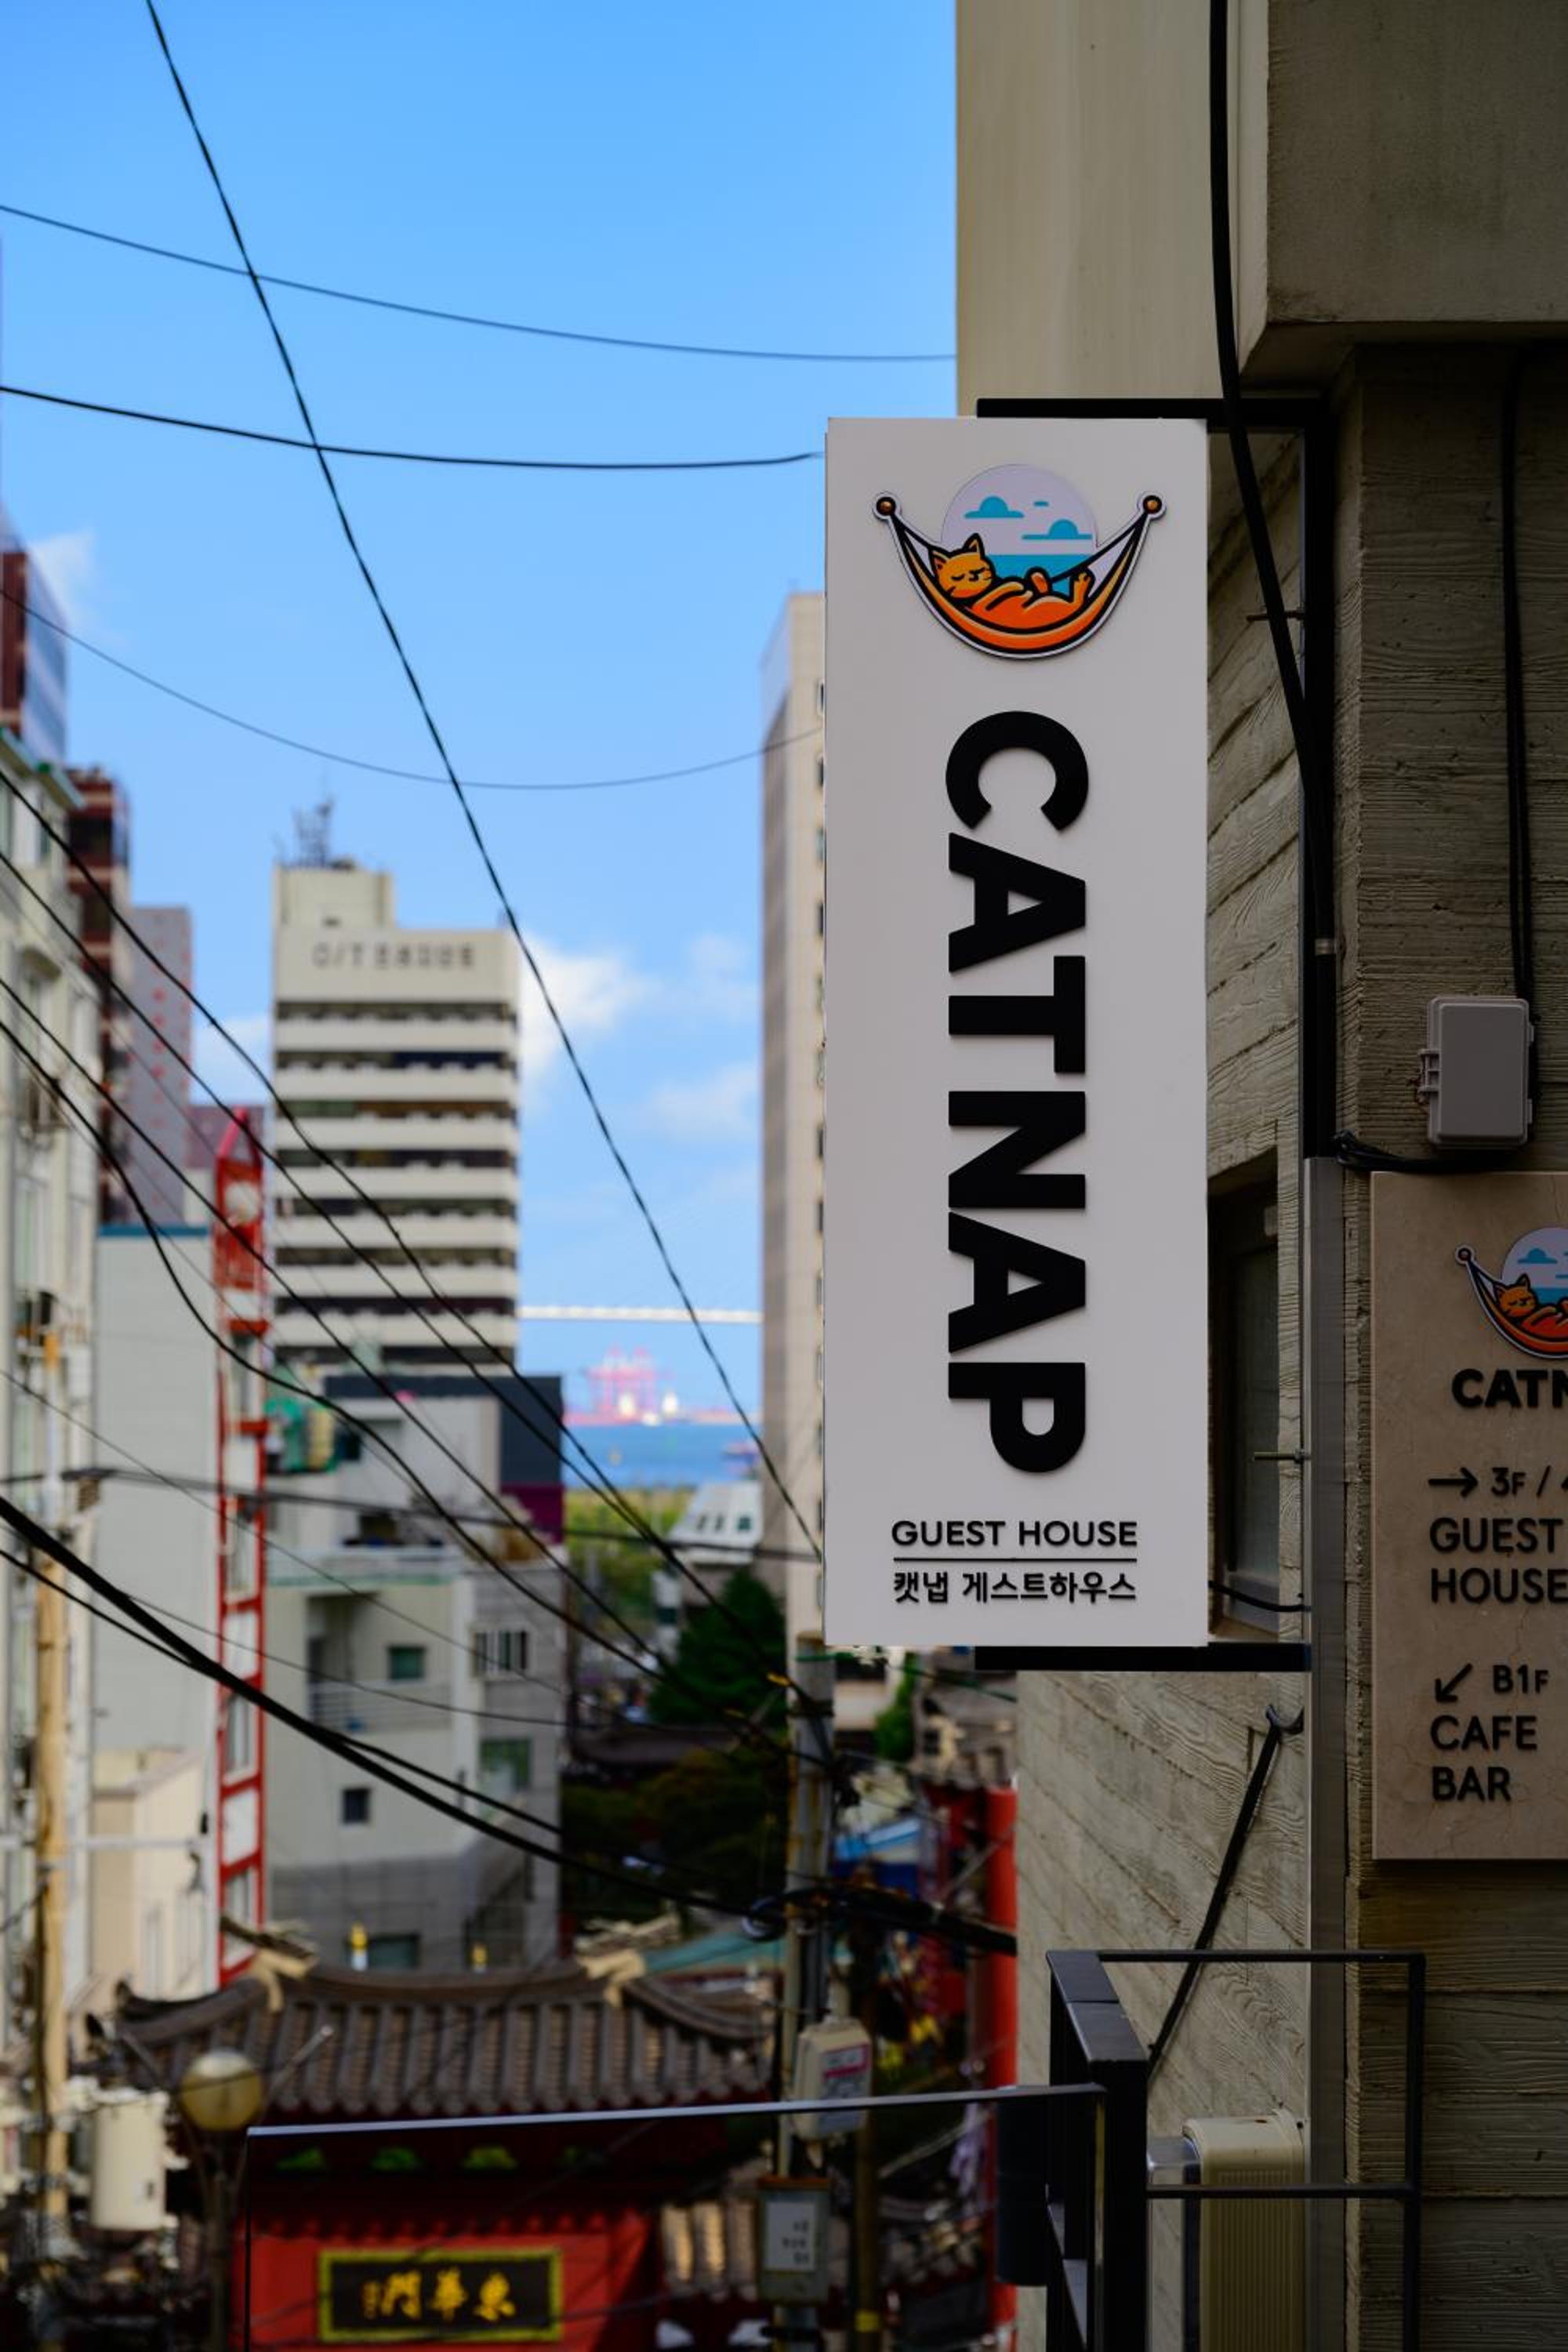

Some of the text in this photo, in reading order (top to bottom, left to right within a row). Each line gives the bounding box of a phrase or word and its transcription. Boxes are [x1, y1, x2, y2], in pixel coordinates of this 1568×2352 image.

[945, 710, 1090, 1475] CATNAP
[1490, 1467, 1526, 1498] 3F
[891, 1521, 1138, 1547] GUEST HOUSE
[1429, 1517, 1564, 1554] GUEST
[894, 1571, 1136, 1604] 캣냅 게스트하우스
[1431, 1567, 1568, 1605] HOUSE
[1492, 1664, 1548, 1696] B1F
[1429, 1715, 1537, 1752] CAFE
[1432, 1766, 1512, 1803] BAR
